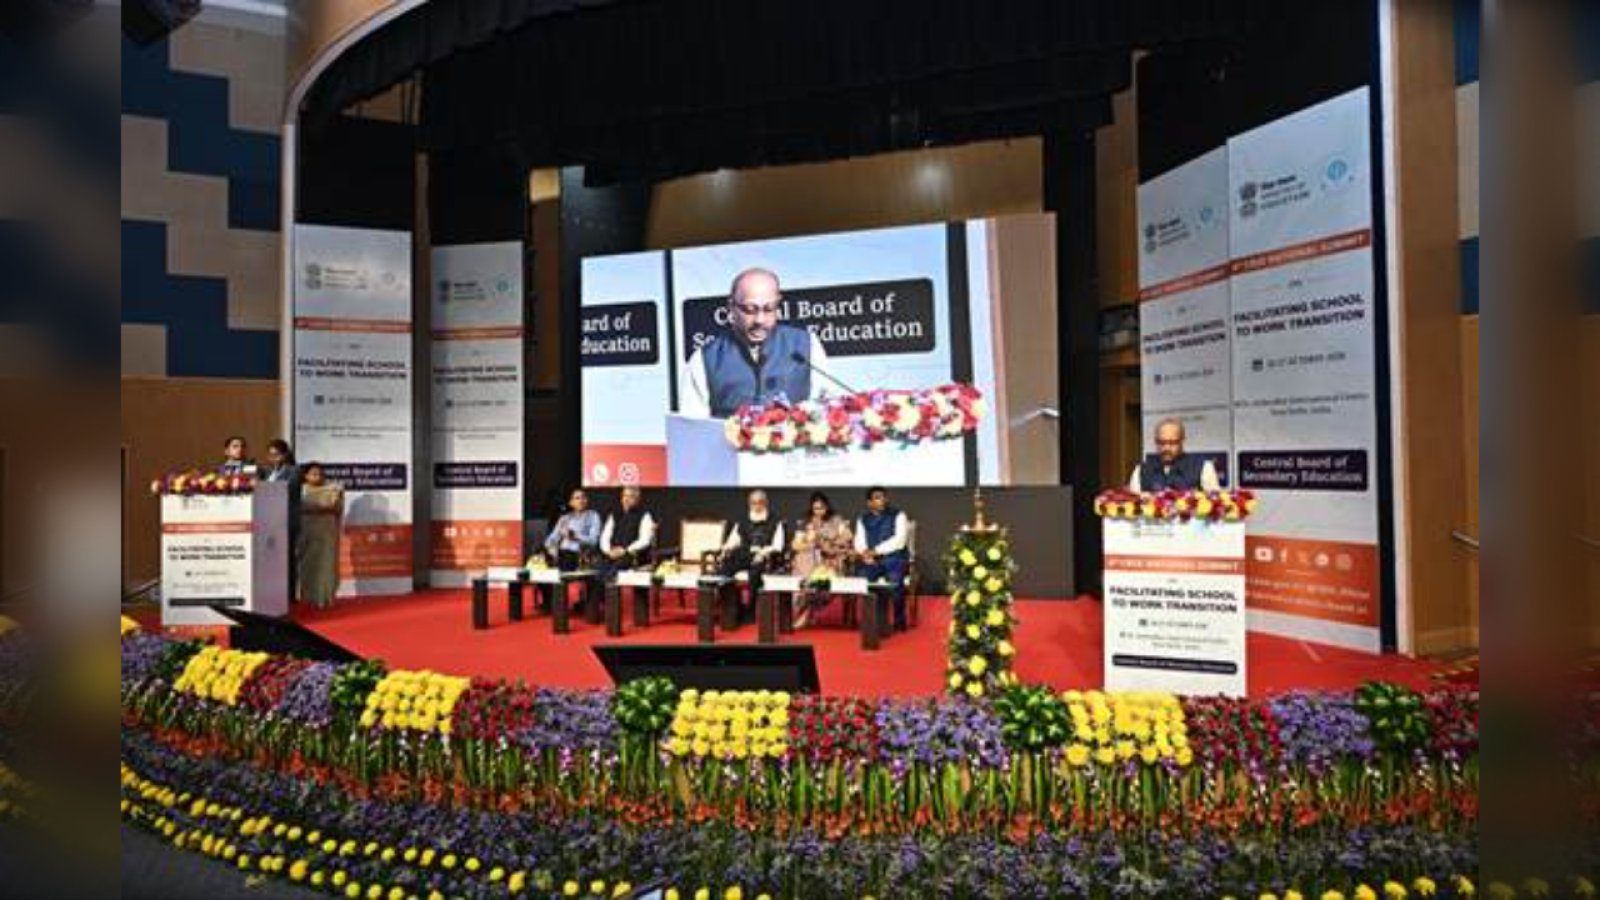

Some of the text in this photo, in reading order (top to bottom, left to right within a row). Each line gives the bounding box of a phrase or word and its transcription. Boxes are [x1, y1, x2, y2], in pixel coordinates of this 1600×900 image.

[797, 295, 863, 318] Board
[870, 290, 896, 313] of
[1234, 292, 1363, 322] FACILITATING SCHOOL
[612, 310, 632, 331] of
[807, 317, 923, 342] Education
[1236, 308, 1364, 336] TO WORK TRANSITION
[1253, 454, 1349, 469] Central Board of
[1243, 469, 1363, 486] Secondary Education
[1109, 586, 1238, 601] FACILITATING SCHOOL
[1112, 597, 1126, 608] TO
[1130, 599, 1162, 610] WORK
[1166, 601, 1238, 614] TRANSITION
